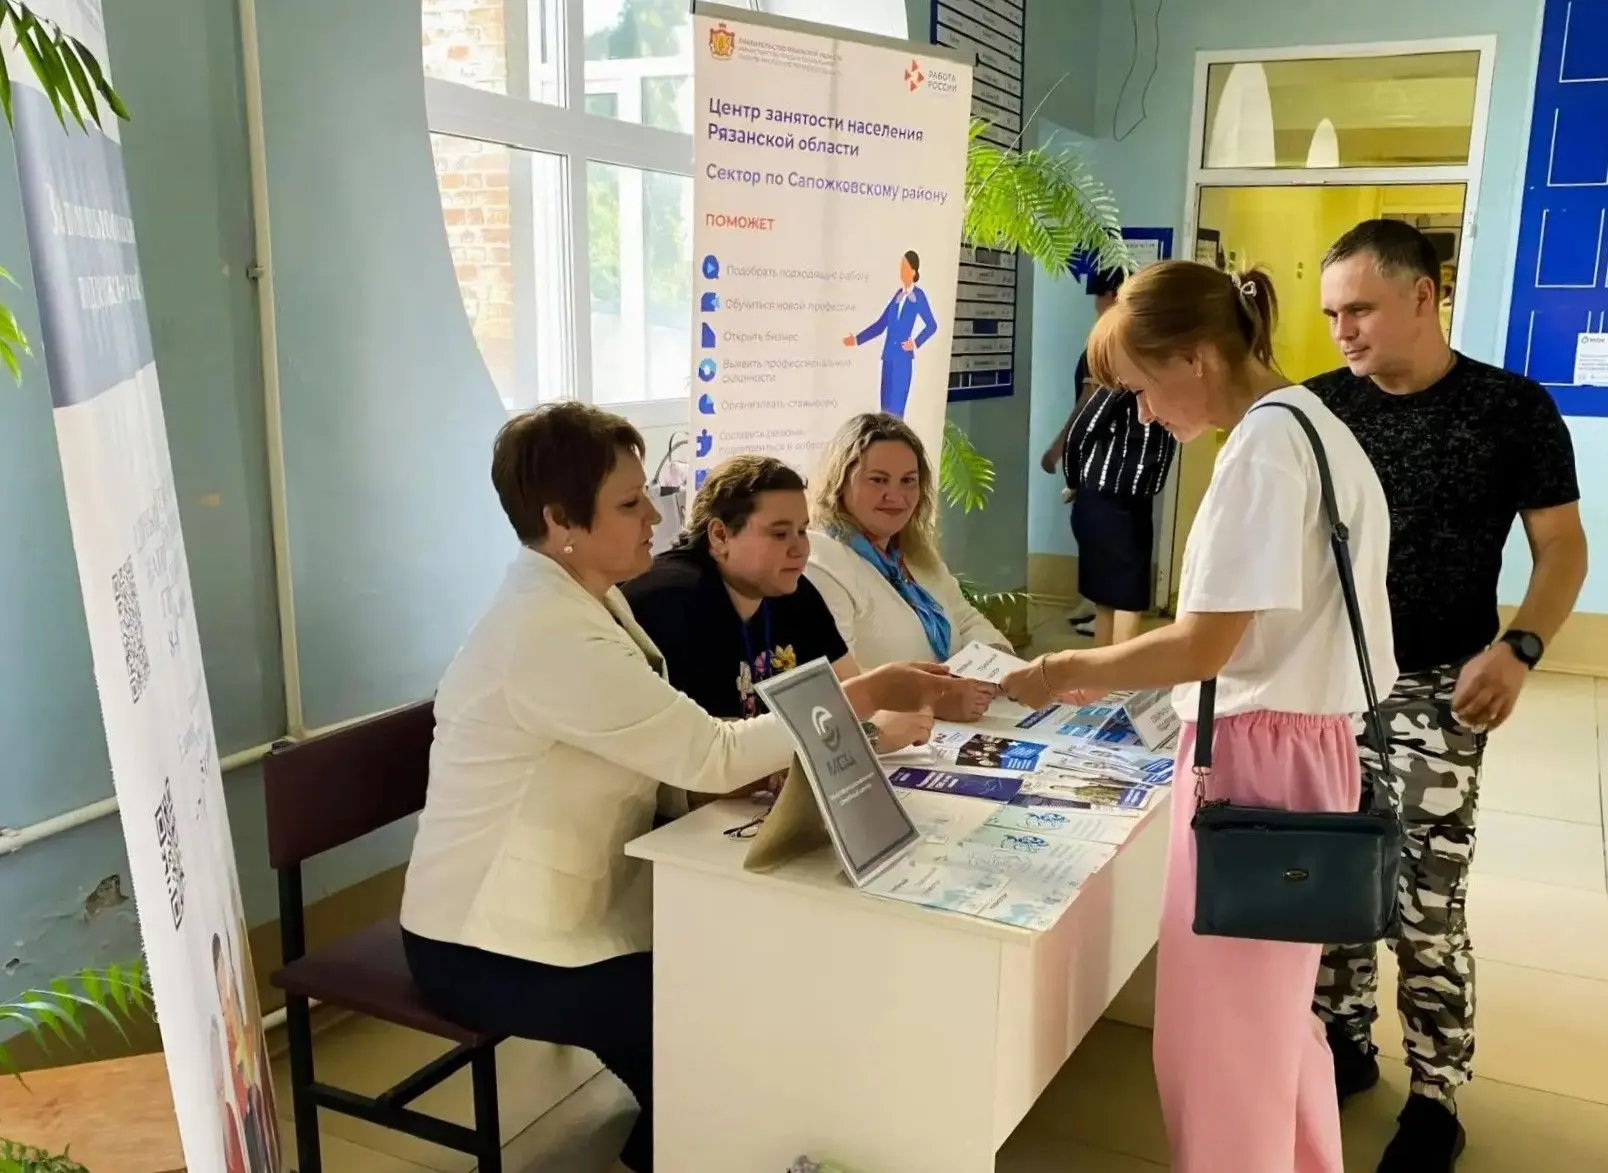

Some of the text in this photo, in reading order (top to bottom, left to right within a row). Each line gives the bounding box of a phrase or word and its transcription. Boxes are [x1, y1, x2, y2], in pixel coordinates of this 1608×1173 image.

[929, 70, 956, 82] РАБОТА
[928, 80, 957, 92] РОССИИ
[709, 97, 924, 142] Центр занятости населения
[708, 123, 860, 157] Рязанской области
[706, 163, 948, 206] Сектор по Сапожковскому району
[706, 213, 776, 231] ПОМОЖЕТ
[726, 264, 778, 279] Подобрать
